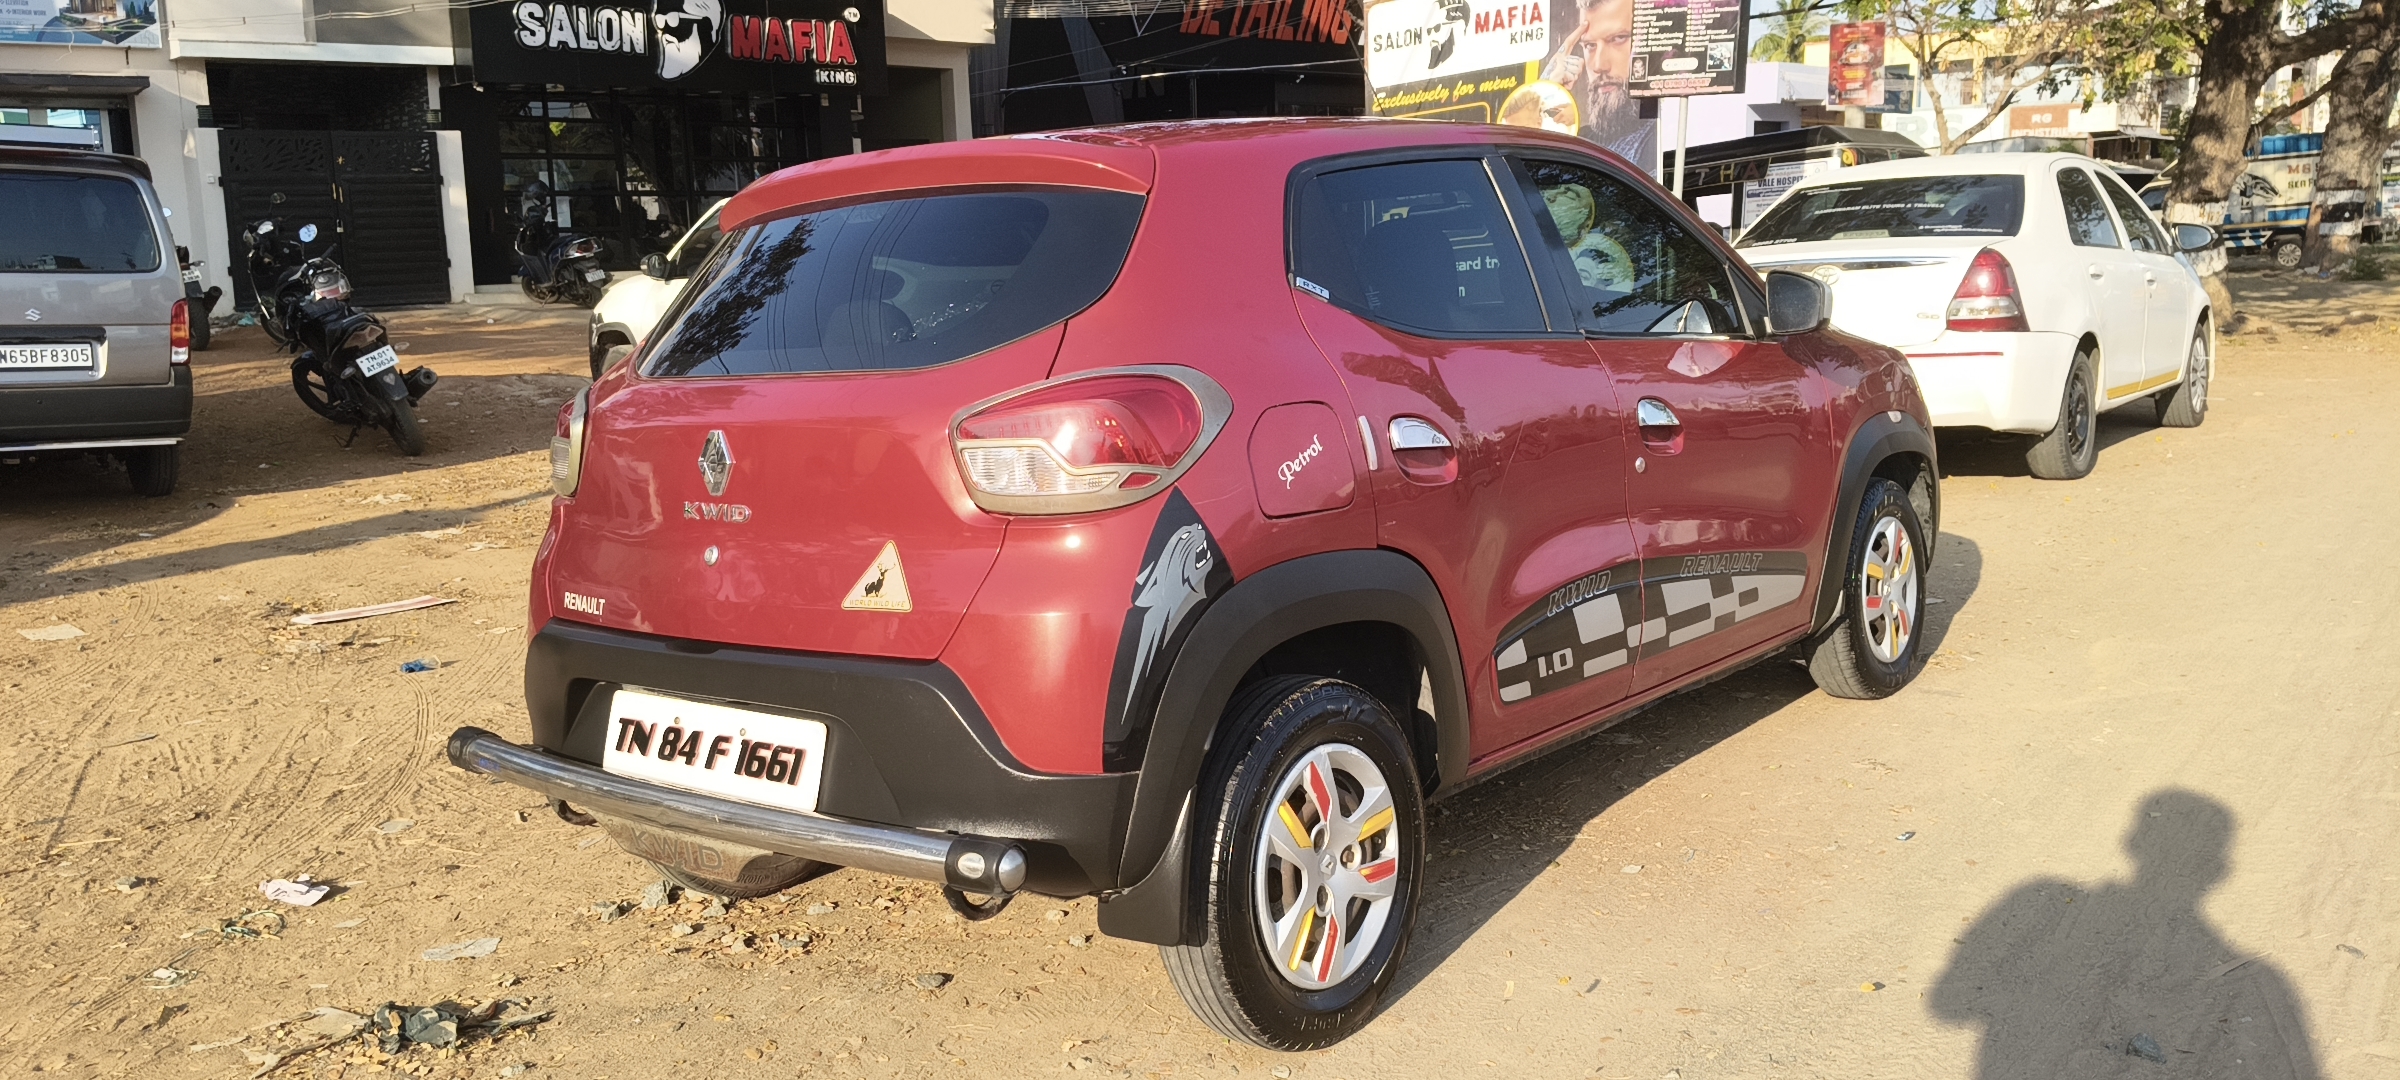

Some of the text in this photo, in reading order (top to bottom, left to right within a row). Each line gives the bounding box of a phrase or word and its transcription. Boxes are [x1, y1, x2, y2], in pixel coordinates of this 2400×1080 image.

[517, 2, 646, 54] SALON
[730, 15, 857, 64] MAFIA
[1373, 2, 1543, 53] SALON MAFIA
[1509, 28, 1544, 45] KING
[818, 70, 856, 85] KING
[1372, 76, 1517, 112] Exclusively for mens
[1302, 281, 1325, 295] RXT
[0, 349, 89, 364] N65BF8305
[1277, 433, 1323, 490] Petrol
[683, 501, 753, 523] KWID
[1680, 553, 1763, 577] RENAULT
[563, 591, 606, 616] RENAULT
[849, 599, 872, 607] WORLD
[891, 600, 906, 608] LIFE
[1546, 570, 1611, 617] KWID
[1537, 647, 1574, 678] 1.0
[615, 717, 807, 786] TN 84 F 1661
[630, 826, 723, 870] KWID
